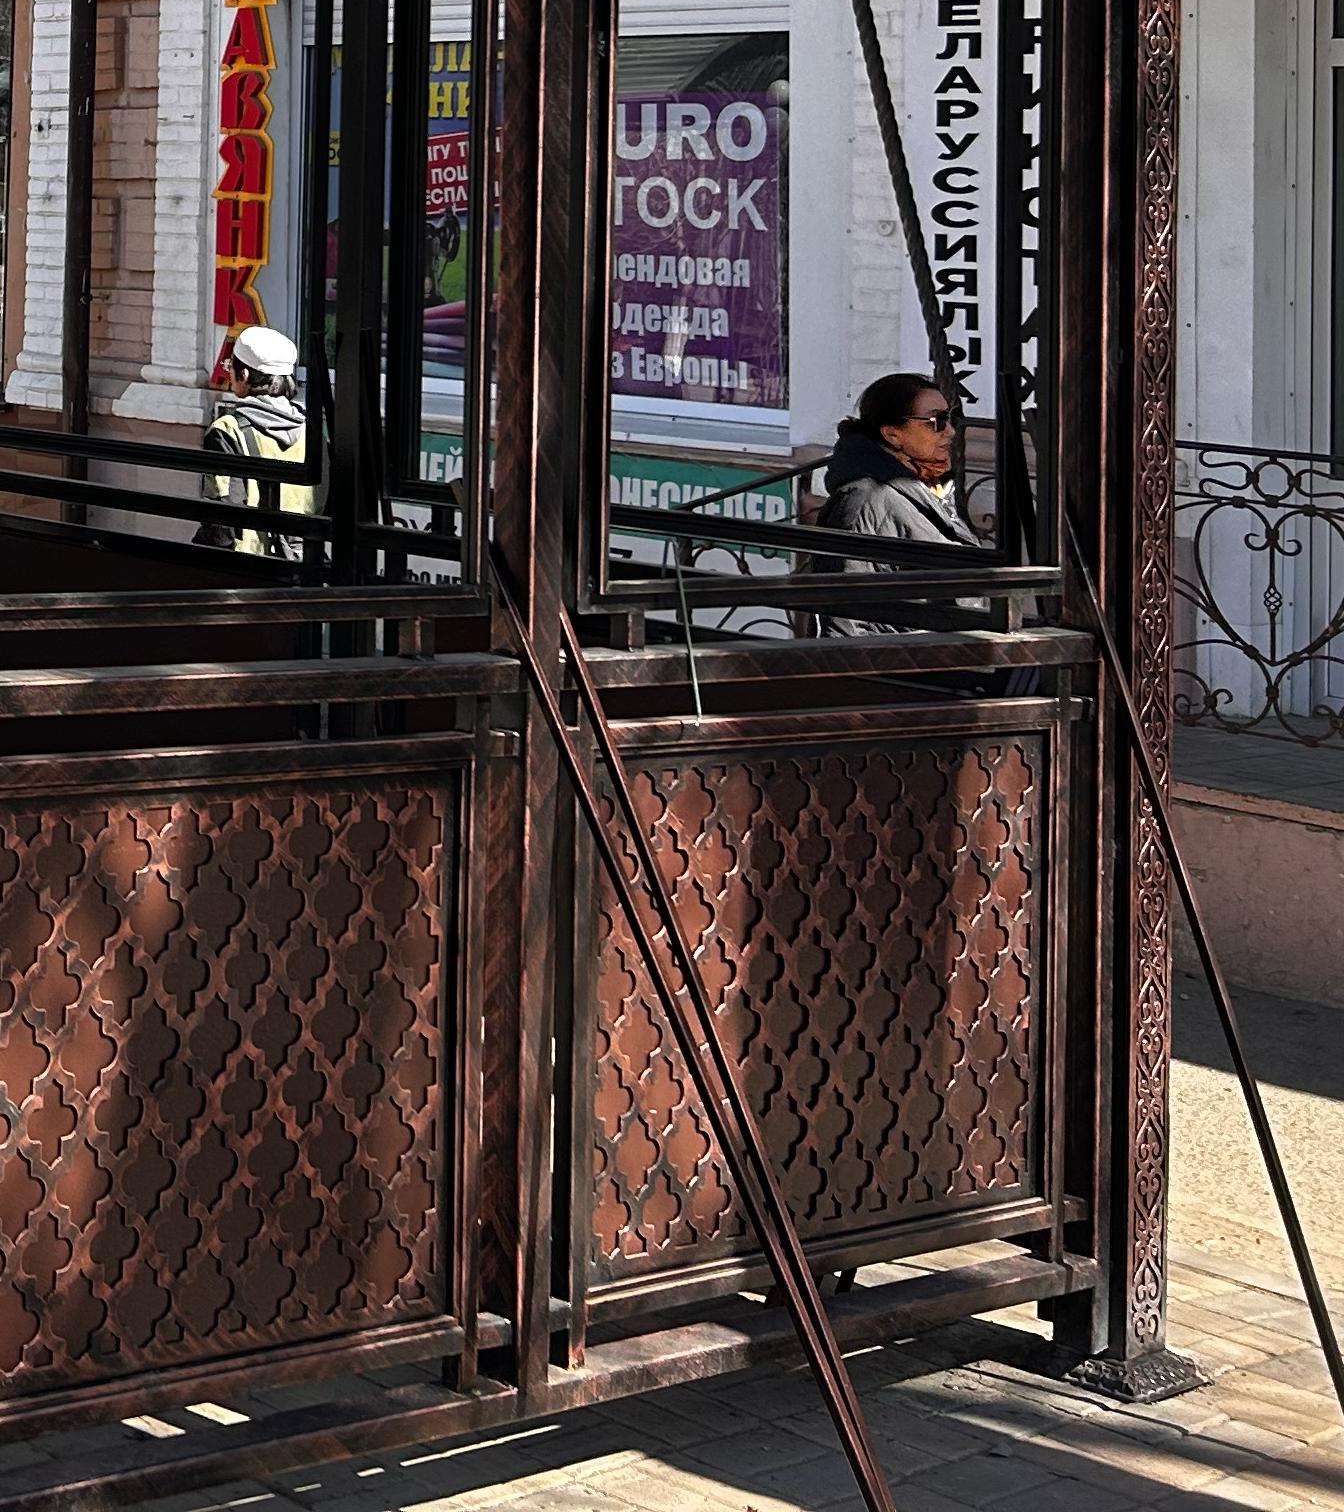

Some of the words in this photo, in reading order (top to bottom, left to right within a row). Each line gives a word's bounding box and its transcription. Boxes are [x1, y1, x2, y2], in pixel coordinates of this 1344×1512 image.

[614, 101, 768, 162] URO
[614, 176, 769, 231] TOCK
[613, 252, 751, 289] ендовая
[631, 346, 748, 390] Европы
